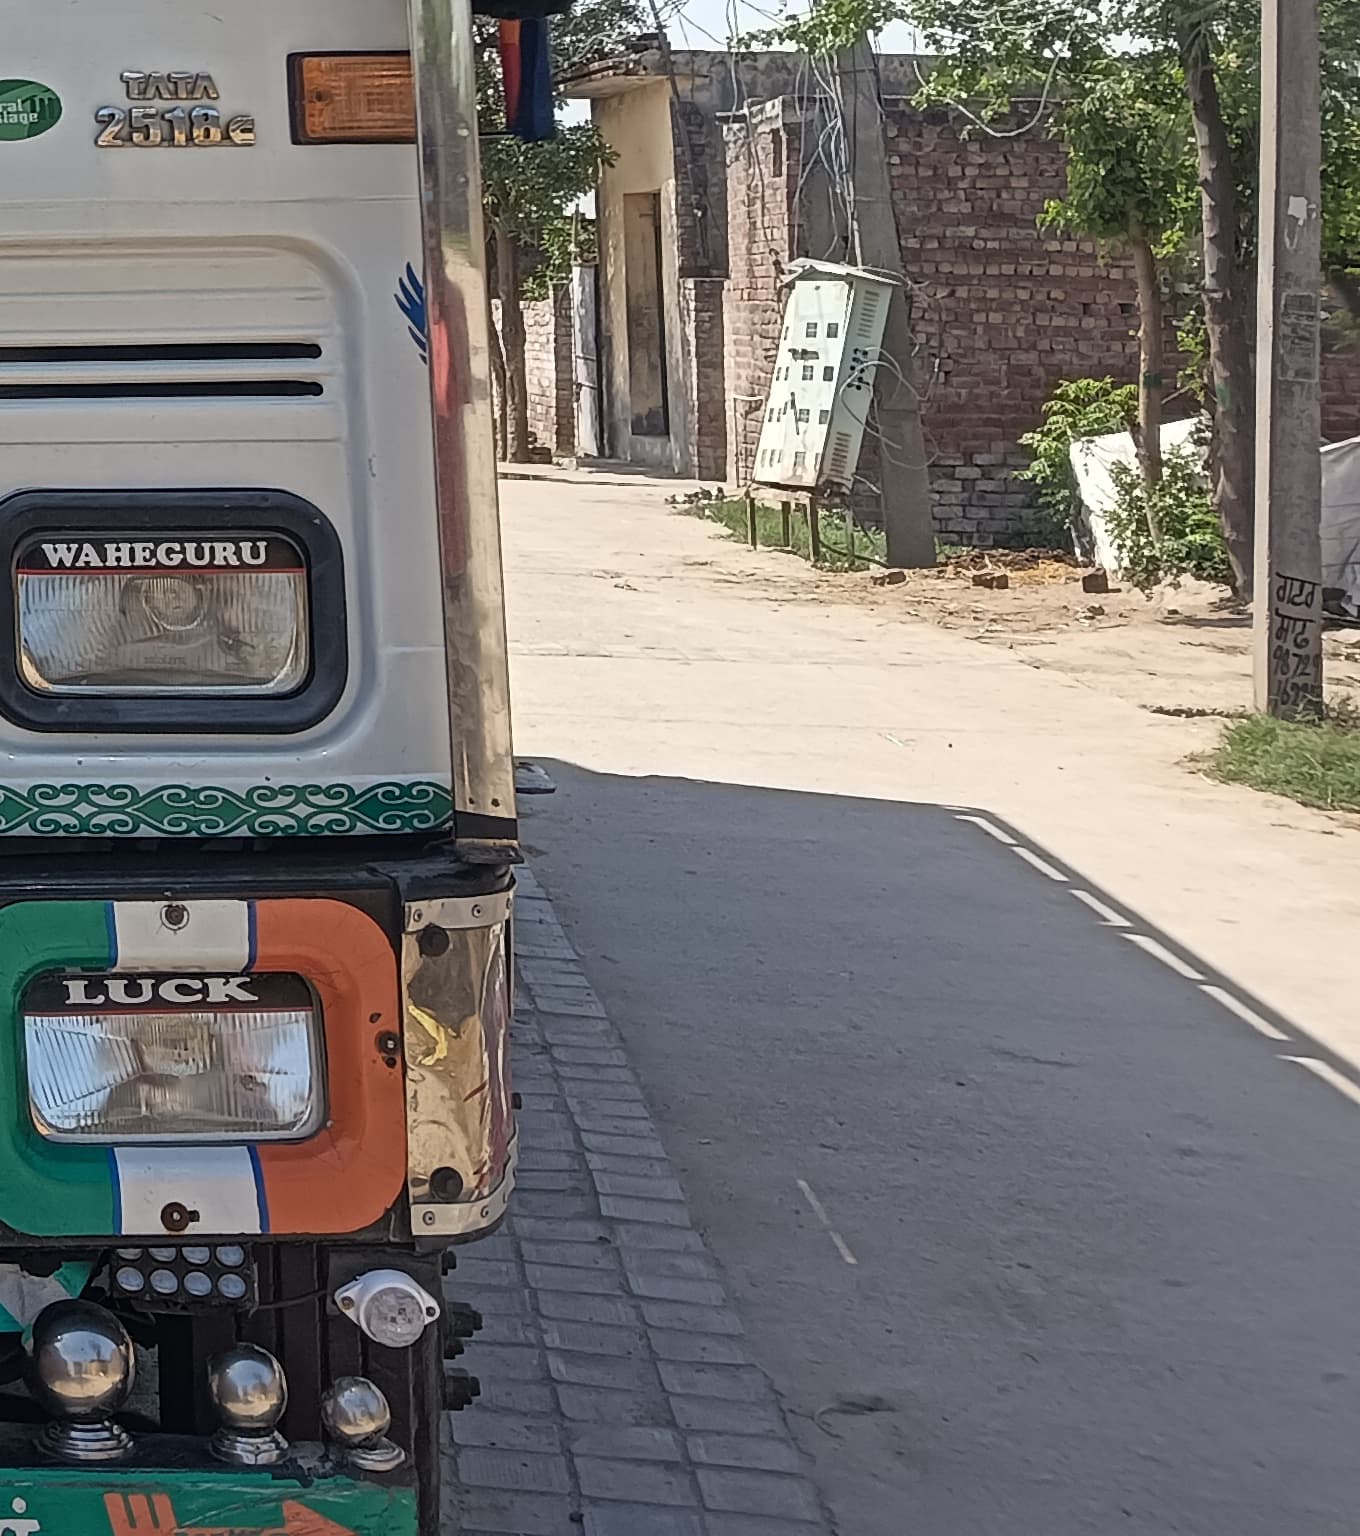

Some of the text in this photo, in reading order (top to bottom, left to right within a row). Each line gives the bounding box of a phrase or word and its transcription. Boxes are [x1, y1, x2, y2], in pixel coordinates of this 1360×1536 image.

[119, 70, 220, 101] TATA
[41, 541, 268, 568] WAHEGURU
[62, 976, 259, 1006] LUCK
